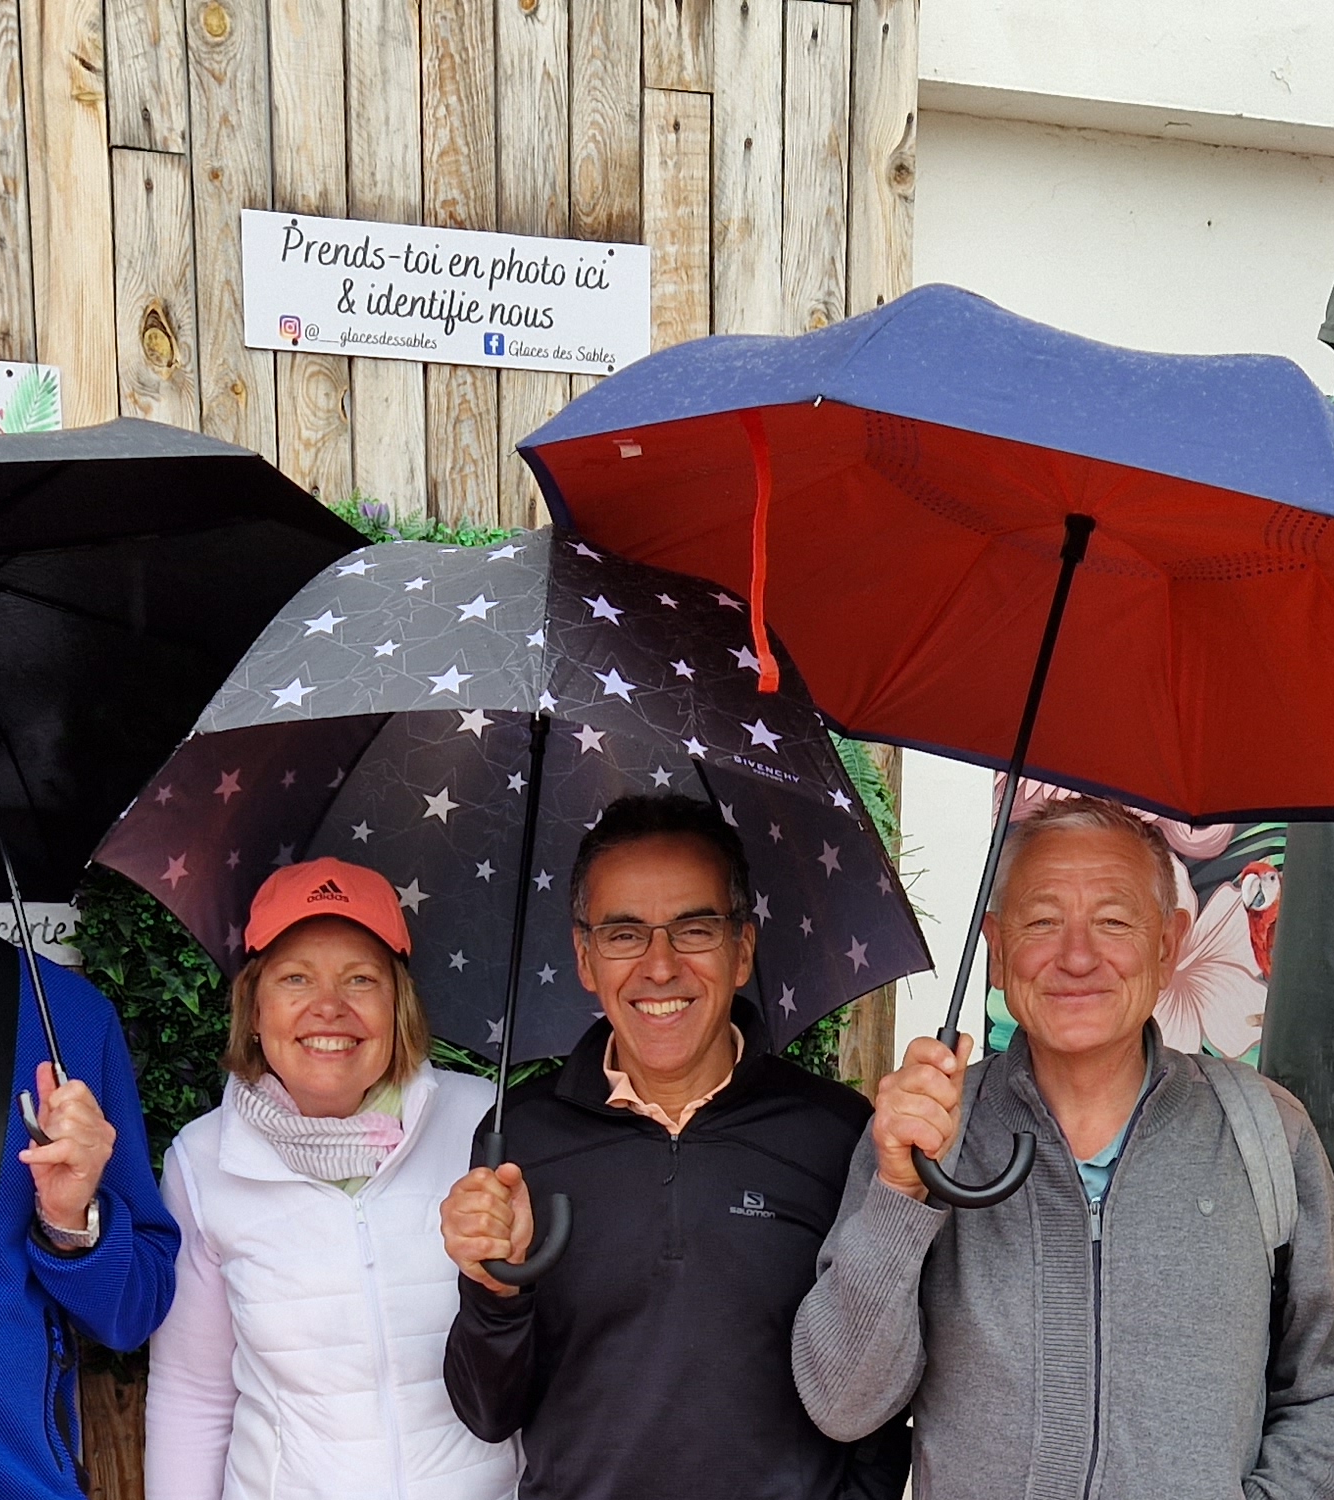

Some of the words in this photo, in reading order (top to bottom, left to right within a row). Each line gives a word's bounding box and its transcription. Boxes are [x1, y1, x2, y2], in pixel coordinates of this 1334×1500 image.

[281, 225, 443, 275] Prends-toi
[449, 252, 485, 278] en
[487, 247, 566, 296] photo
[575, 257, 610, 290] ici
[336, 278, 357, 315] &
[367, 283, 485, 336] identifie
[488, 302, 555, 330] nous
[508, 340, 550, 360] Glaces
[552, 342, 574, 361] des
[575, 345, 617, 365] Sables
[733, 755, 800, 783] GIVENCHY
[307, 892, 350, 903] adidas
[729, 1206, 776, 1219] salomon
